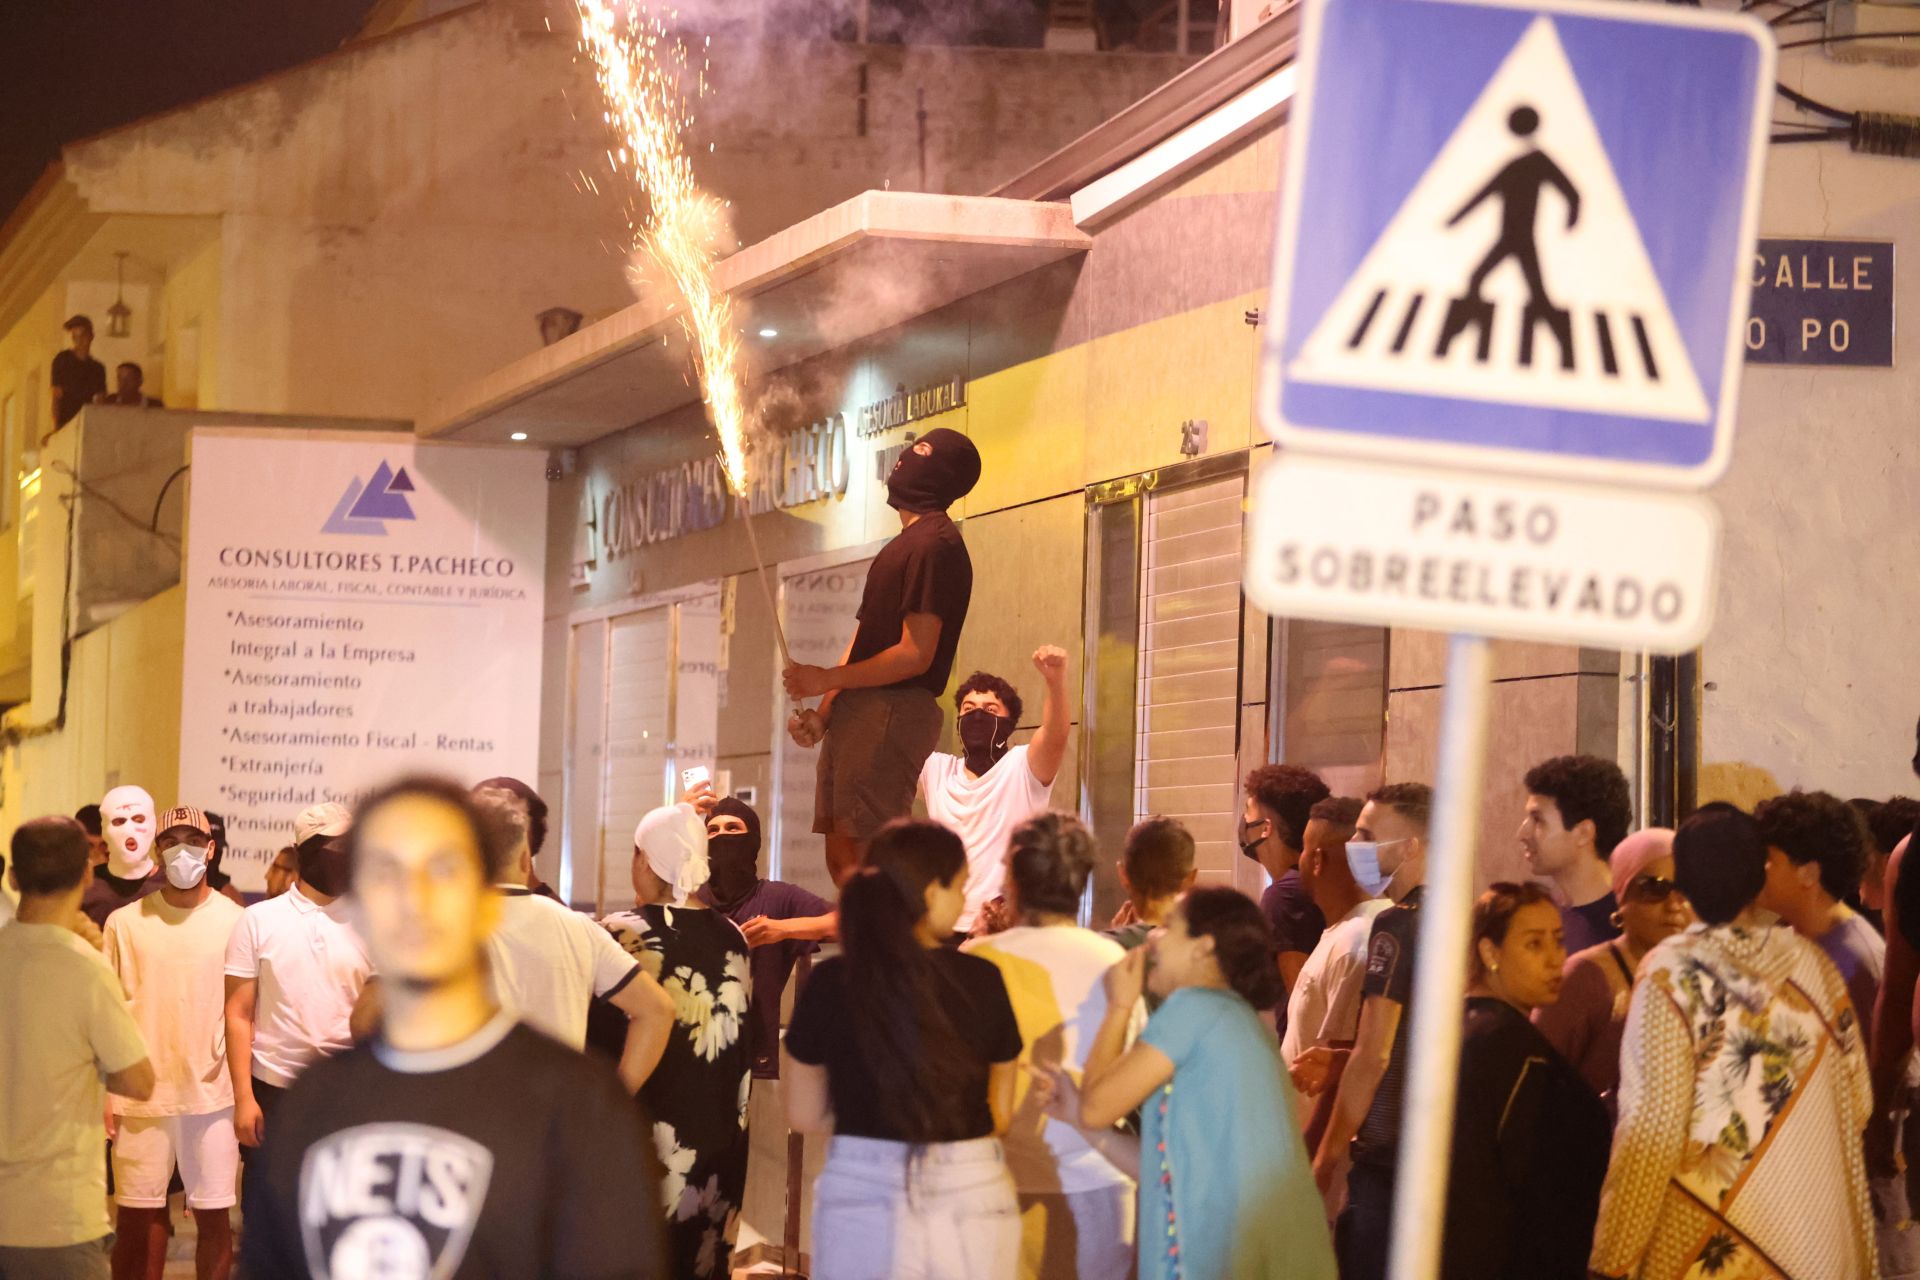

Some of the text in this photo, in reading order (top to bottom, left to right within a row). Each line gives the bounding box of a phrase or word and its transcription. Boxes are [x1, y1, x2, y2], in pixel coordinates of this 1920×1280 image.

[1802, 317, 1850, 352] PO
[1411, 492, 1559, 544] PASO
[219, 547, 382, 573] CONSULTORES
[387, 584, 451, 597] CONTABLE
[1275, 541, 1684, 624] SOBREELEVADO
[230, 640, 415, 666] Integral a la Empresa
[228, 698, 354, 720] a trabajadores
[366, 731, 416, 749] Fiscal
[436, 735, 494, 753] Rentas
[305, 1136, 475, 1229] NETS
